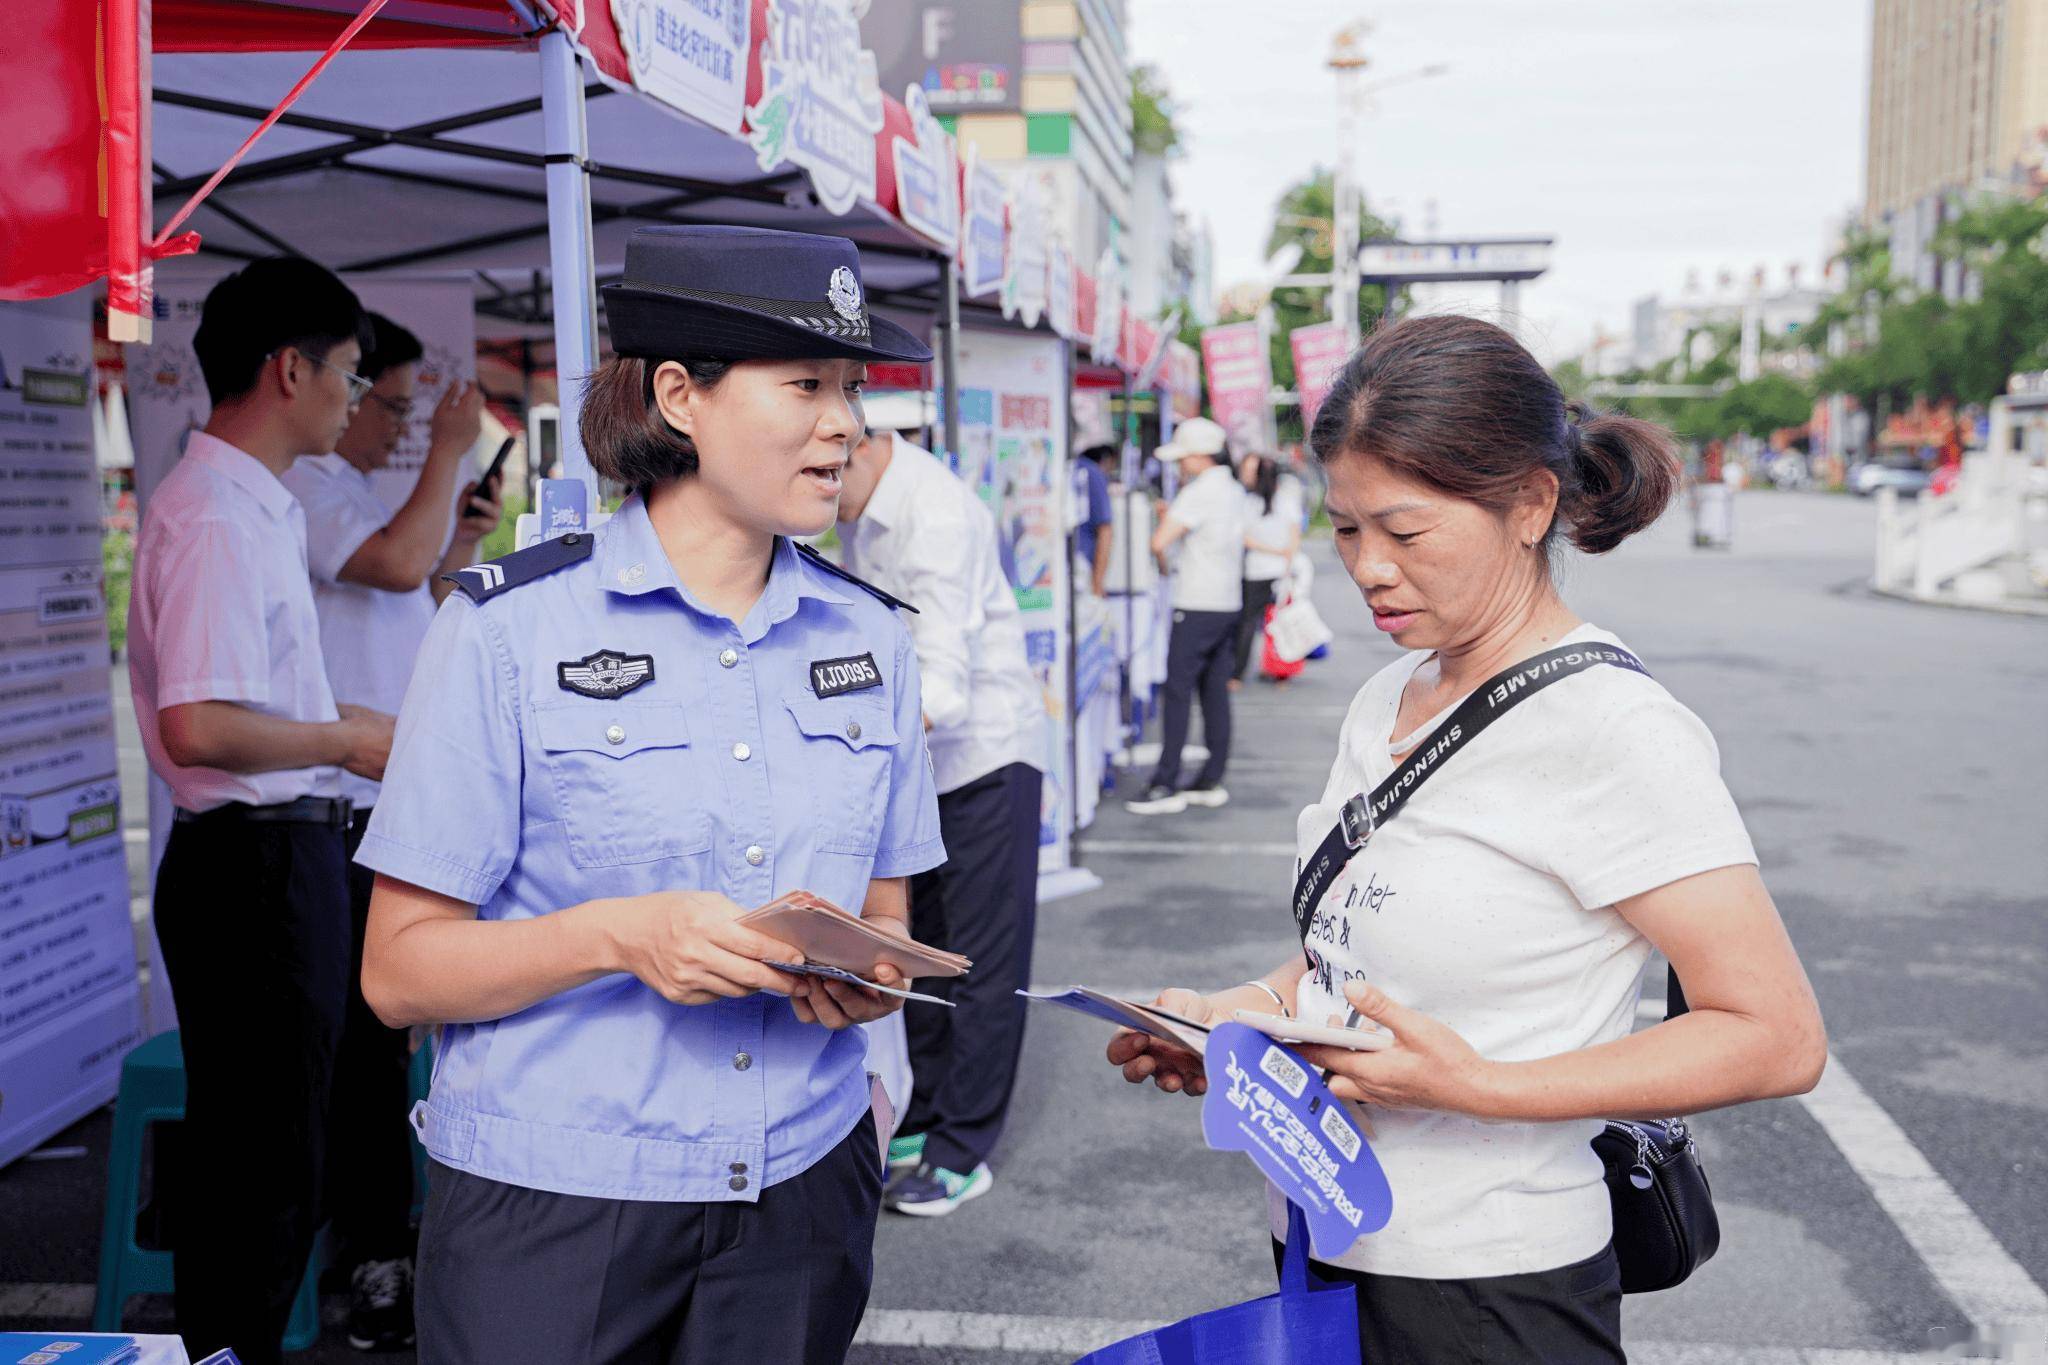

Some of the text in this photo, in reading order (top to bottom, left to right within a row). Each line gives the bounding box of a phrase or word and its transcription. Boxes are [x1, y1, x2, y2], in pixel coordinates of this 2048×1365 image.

[594, 670, 621, 679] POLICE
[1225, 1086, 1364, 1228] 网络安全为人民
